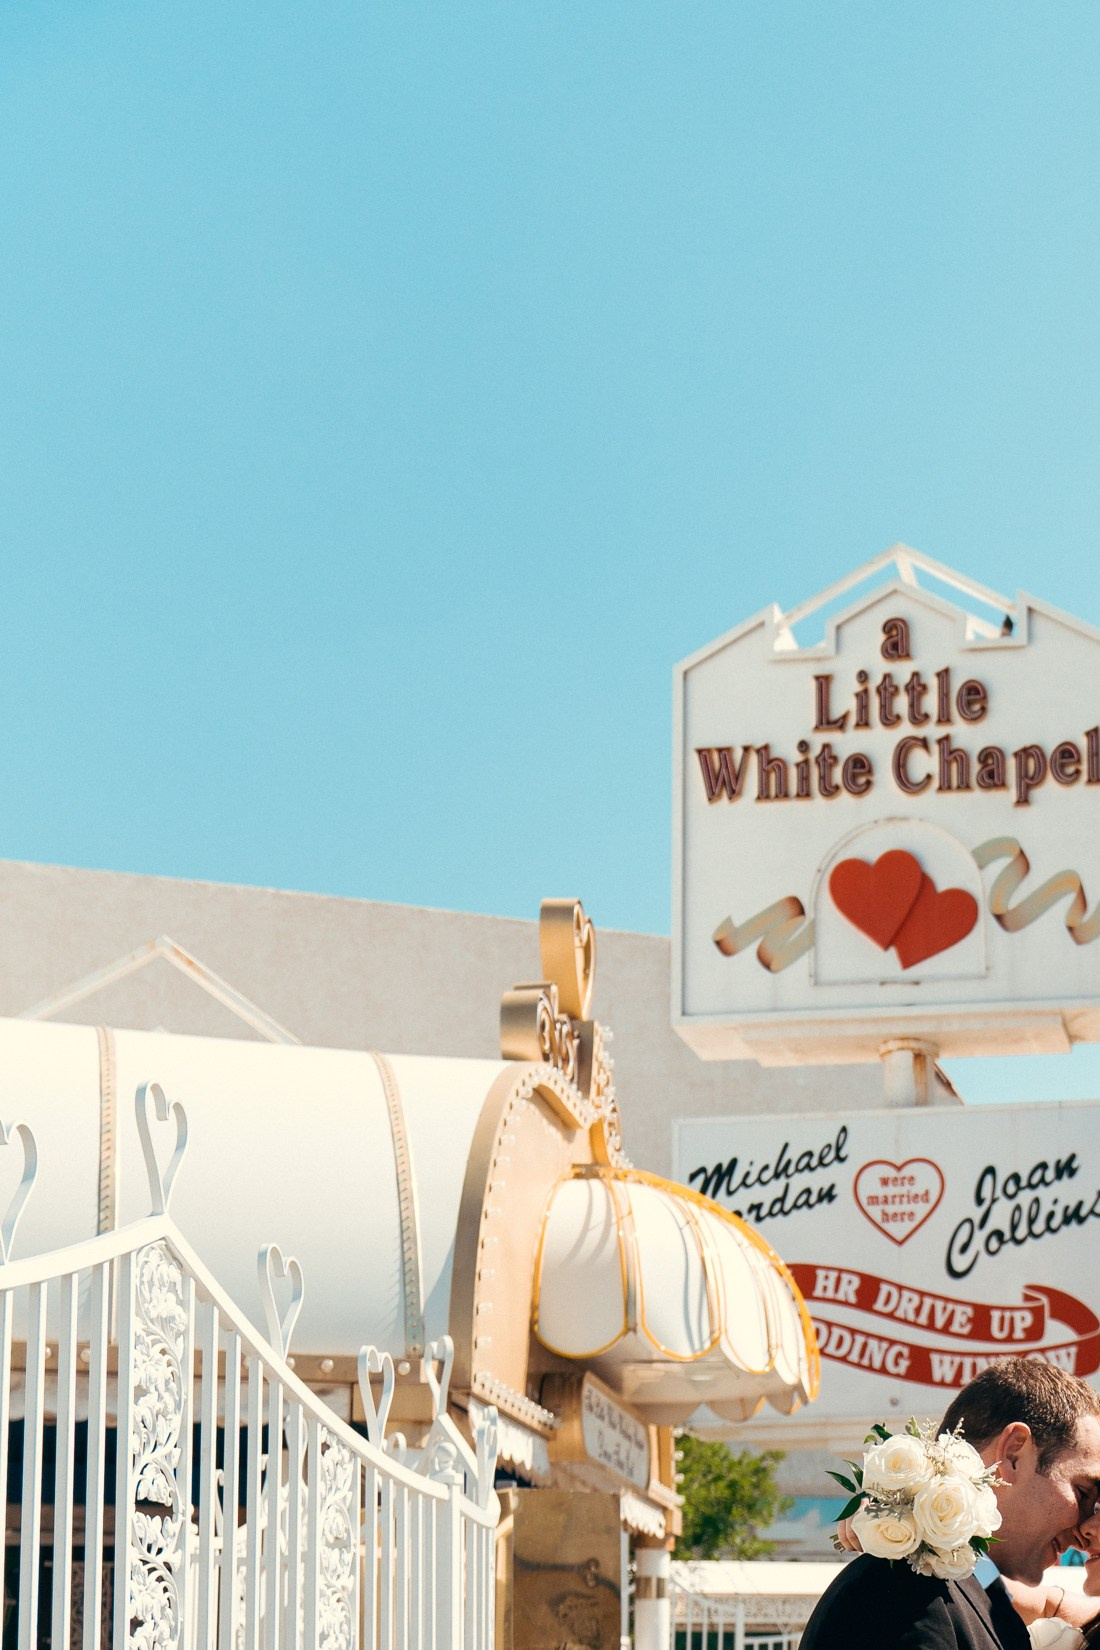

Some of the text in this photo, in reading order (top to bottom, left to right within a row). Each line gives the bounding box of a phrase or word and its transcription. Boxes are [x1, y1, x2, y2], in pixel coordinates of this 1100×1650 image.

[880, 615, 913, 662] a
[812, 666, 989, 734] Little
[695, 739, 874, 805] White
[688, 1125, 849, 1201] Michael
[879, 1175, 916, 1187] were
[974, 1151, 1081, 1229] Joan
[733, 1182, 838, 1223] rdan
[867, 1189, 930, 1206] married
[881, 1209, 915, 1223] here
[812, 1268, 1034, 1340] HR DRIVE UP
[812, 1319, 911, 1376] DDING
